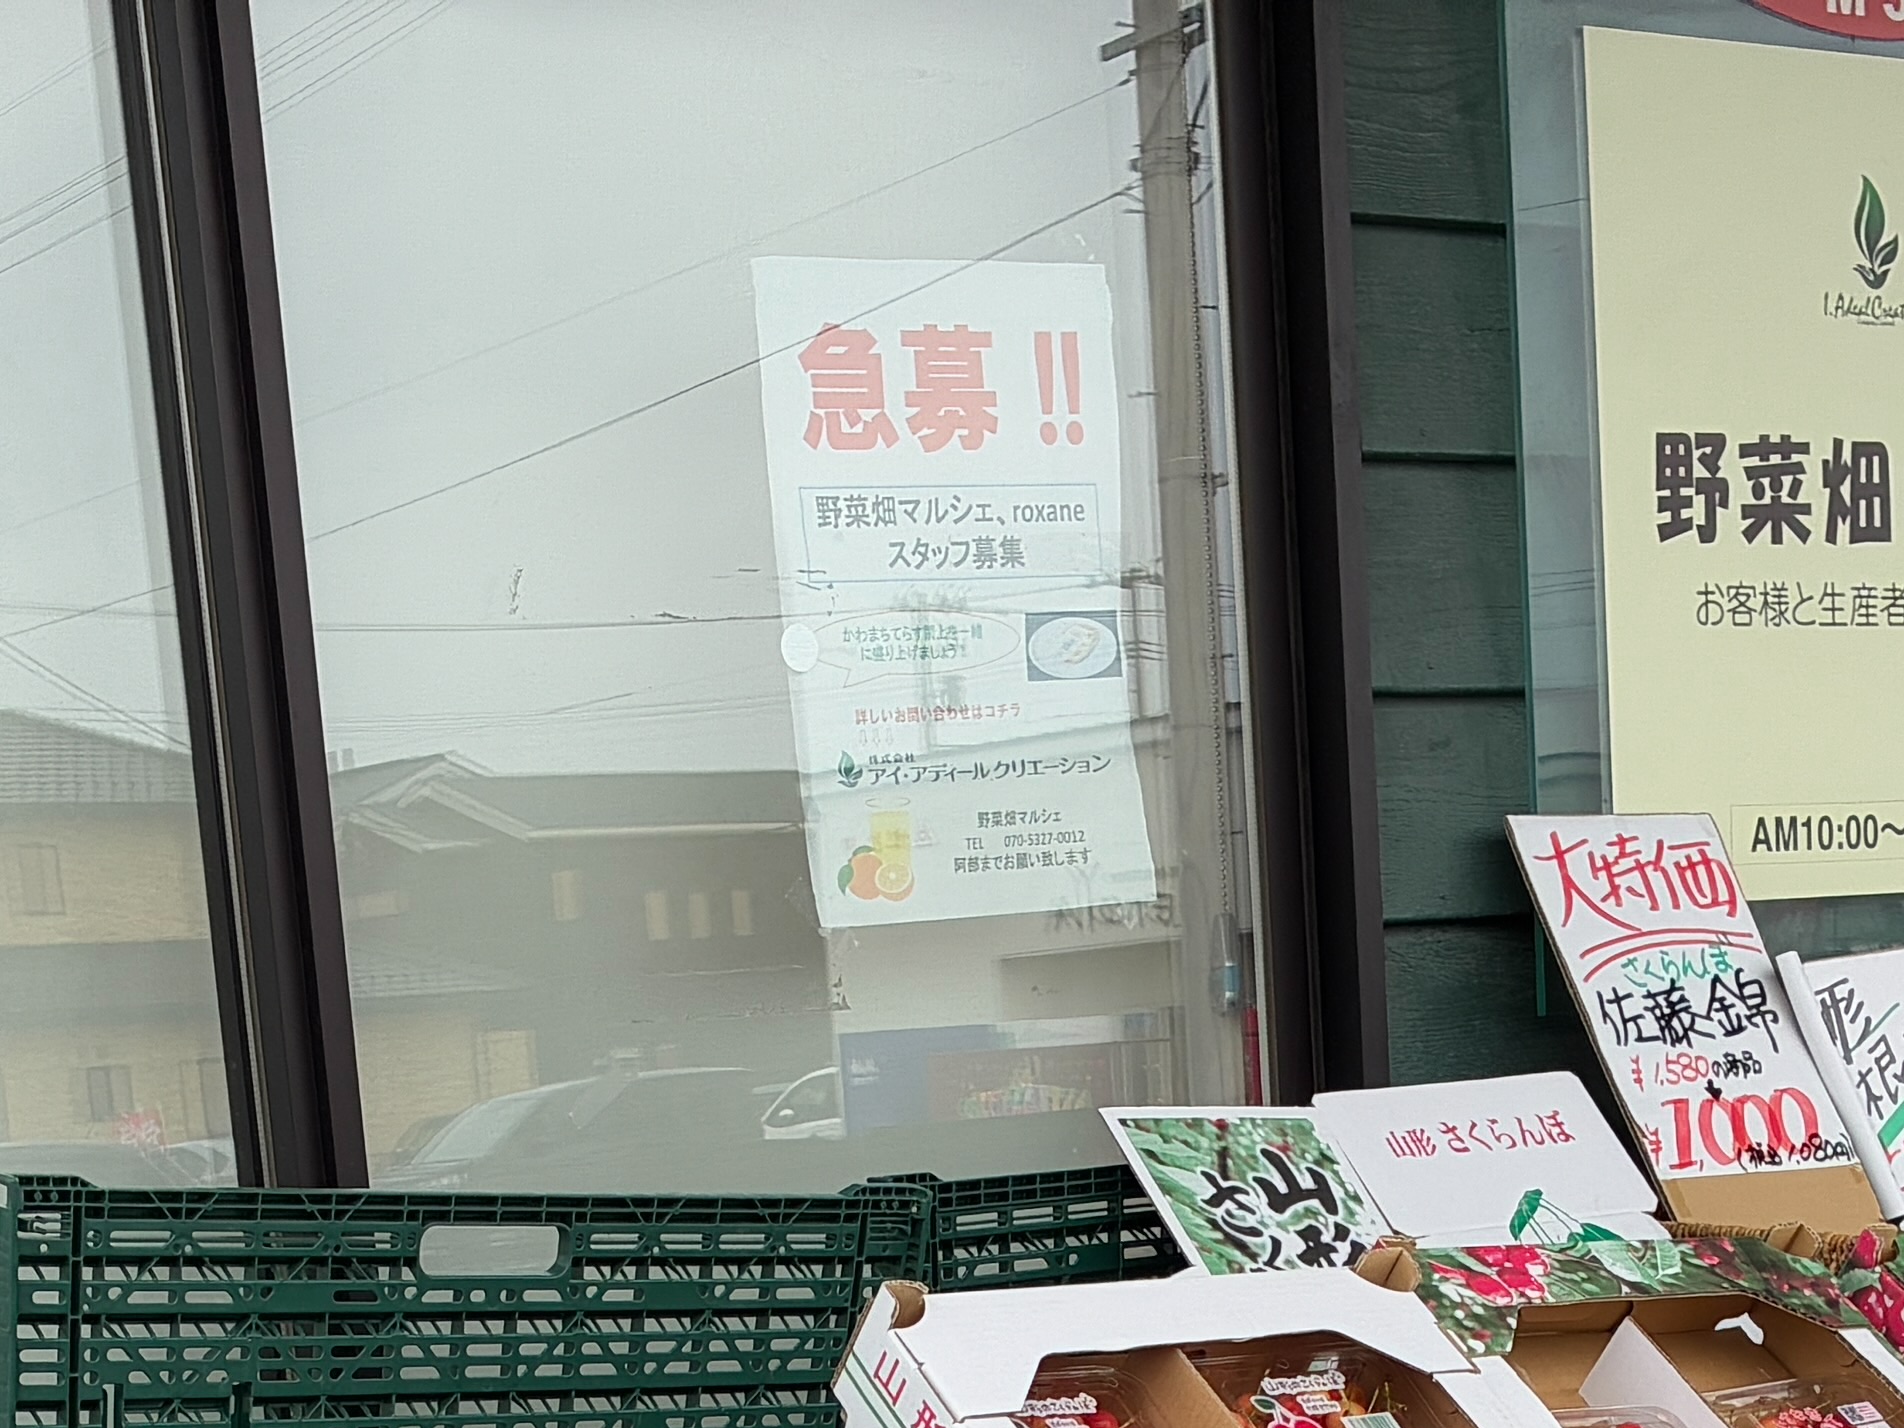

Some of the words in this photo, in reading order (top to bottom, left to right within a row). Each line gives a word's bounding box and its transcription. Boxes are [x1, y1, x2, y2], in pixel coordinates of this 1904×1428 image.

[888, 535, 1026, 570] スタッフ募集
[855, 703, 1021, 725] 詳しいお問い合わせはコチラ
[966, 837, 985, 850] TEL
[1533, 831, 1739, 933] 大特価
[1621, 945, 1737, 990] さくらんぼ
[1598, 967, 1780, 1054] 佐藤錦
